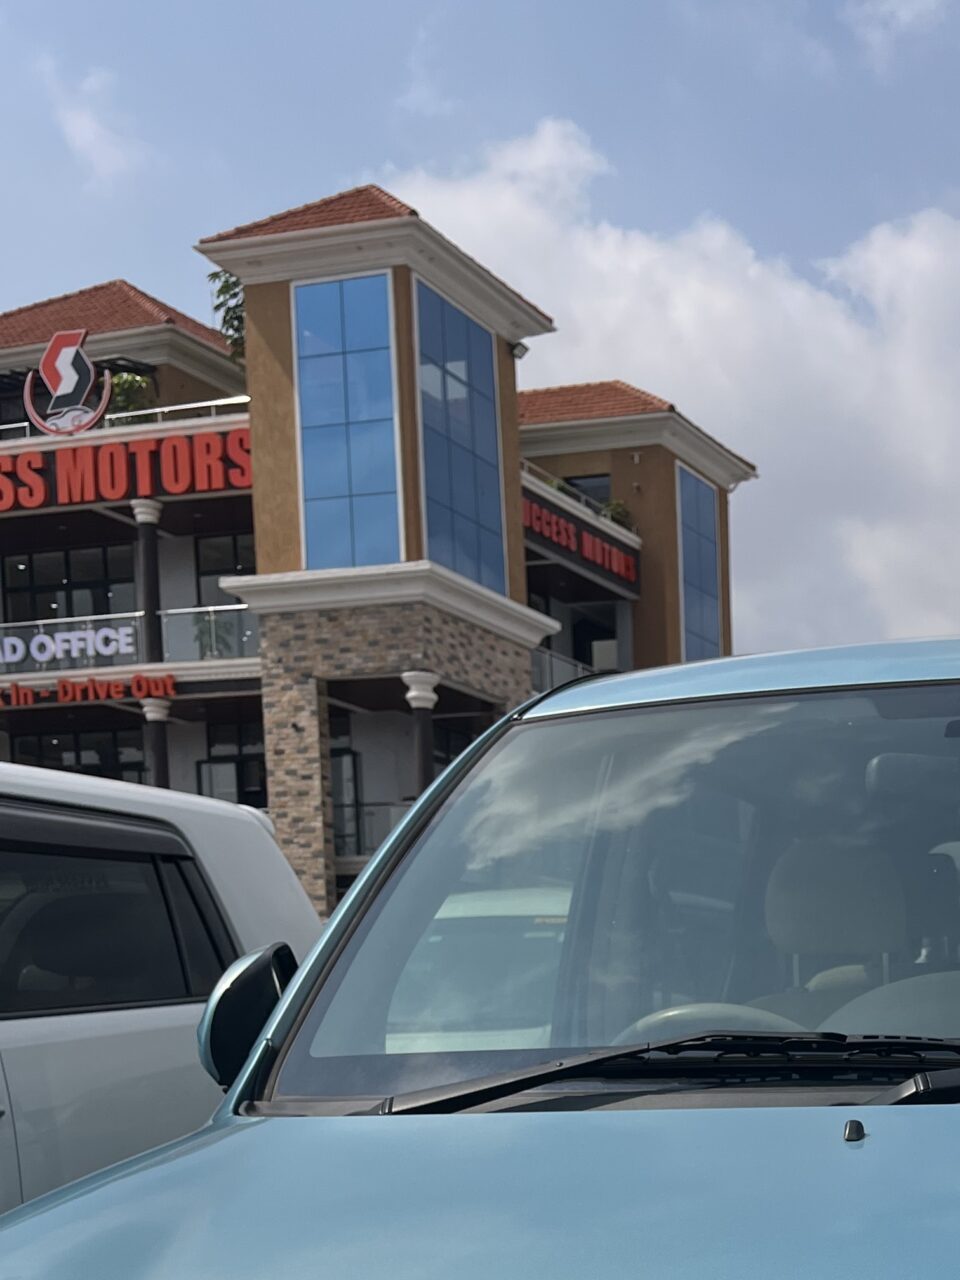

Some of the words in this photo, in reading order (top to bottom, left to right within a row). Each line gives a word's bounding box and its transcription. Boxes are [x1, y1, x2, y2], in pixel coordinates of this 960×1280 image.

[55, 428, 253, 505] MOTORS
[30, 627, 135, 662] OFFICE
[57, 677, 124, 703] Drive
[131, 673, 177, 698] Out
